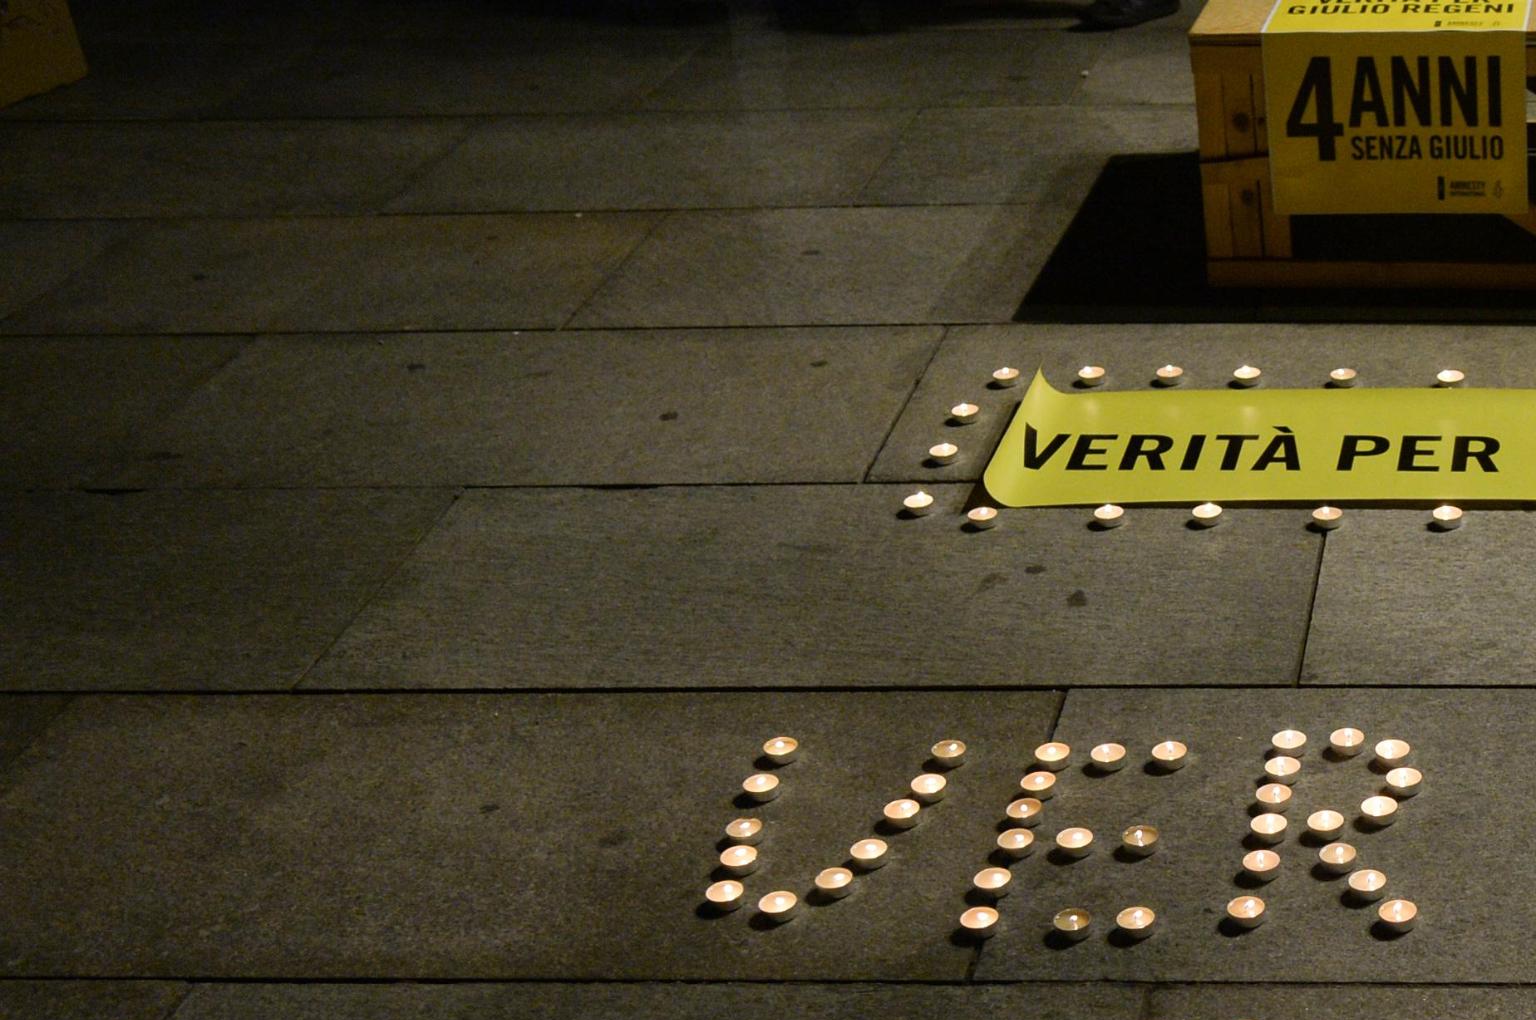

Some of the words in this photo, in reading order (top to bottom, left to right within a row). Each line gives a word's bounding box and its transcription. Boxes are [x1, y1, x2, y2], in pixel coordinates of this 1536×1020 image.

[1288, 4, 1390, 15] GIULIO
[1401, 3, 1514, 14] REGENI
[1286, 56, 1344, 162] 4
[1349, 55, 1502, 128] ANNI
[1350, 135, 1423, 161] SENZA
[1429, 135, 1504, 161] GIULIO
[1024, 424, 1300, 471] VERITÀ
[1336, 434, 1500, 473] PER
